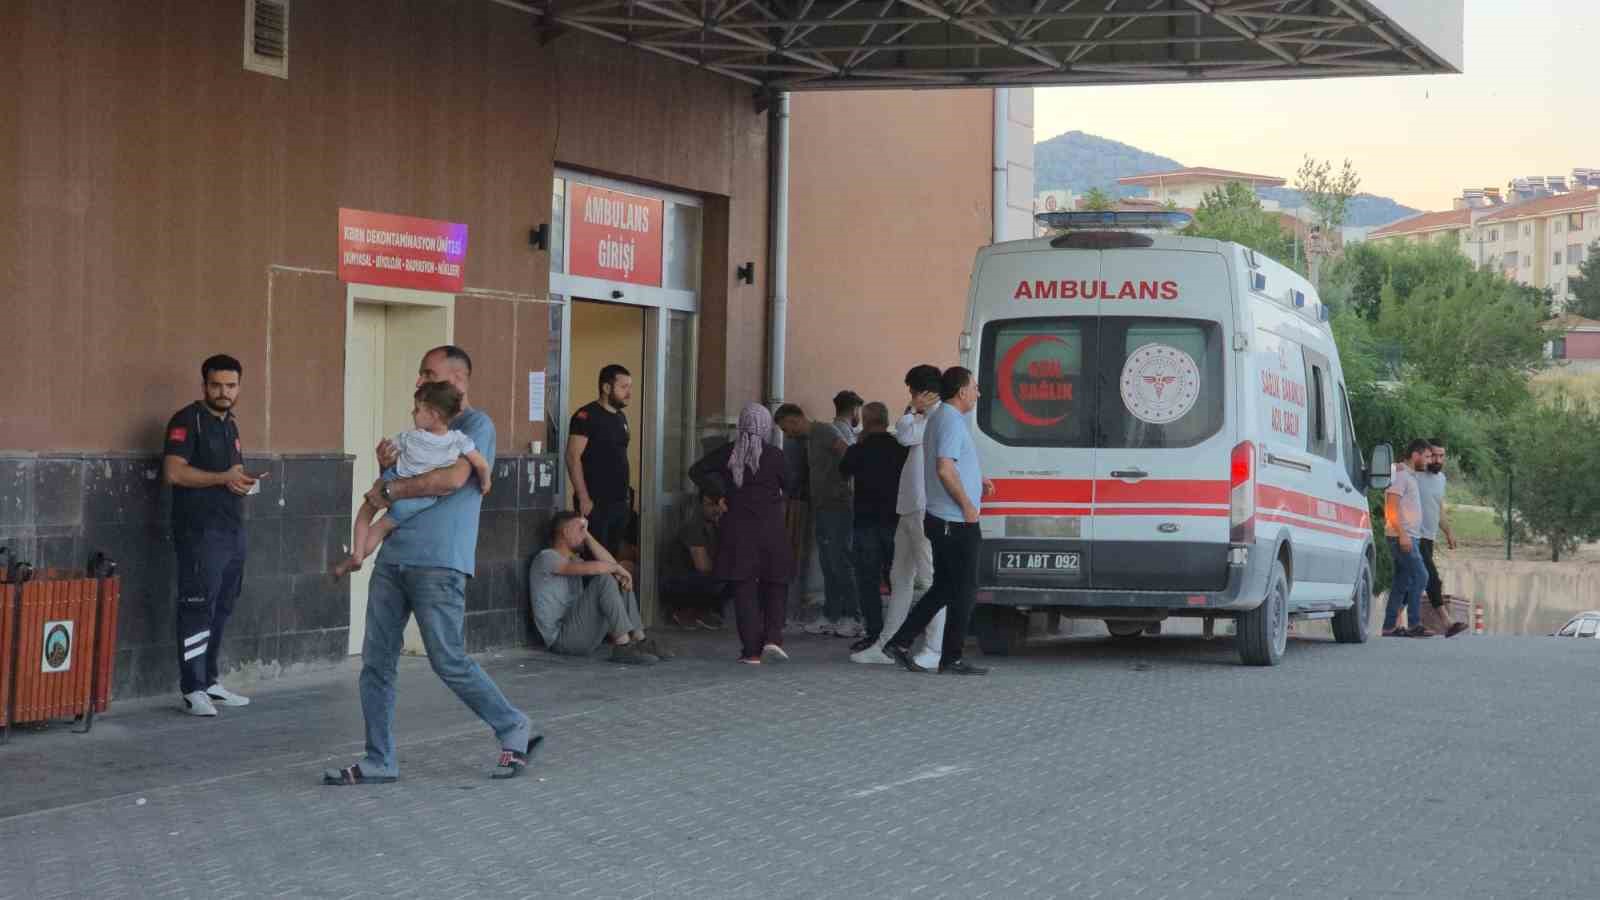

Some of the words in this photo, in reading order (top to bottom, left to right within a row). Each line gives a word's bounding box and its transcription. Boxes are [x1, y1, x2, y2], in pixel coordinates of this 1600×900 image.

[584, 195, 649, 233] AMBULANS
[343, 226, 366, 243] KBRN
[366, 229, 436, 252] DEKONTAMİNASYON
[436, 235, 461, 256] ÜNİTESİ
[598, 234, 636, 278] GİRİŞİ
[1014, 280, 1178, 300] AMBULANS
[1006, 554, 1020, 569] 21
[1027, 554, 1050, 569] ABT
[1055, 554, 1077, 569] 092
